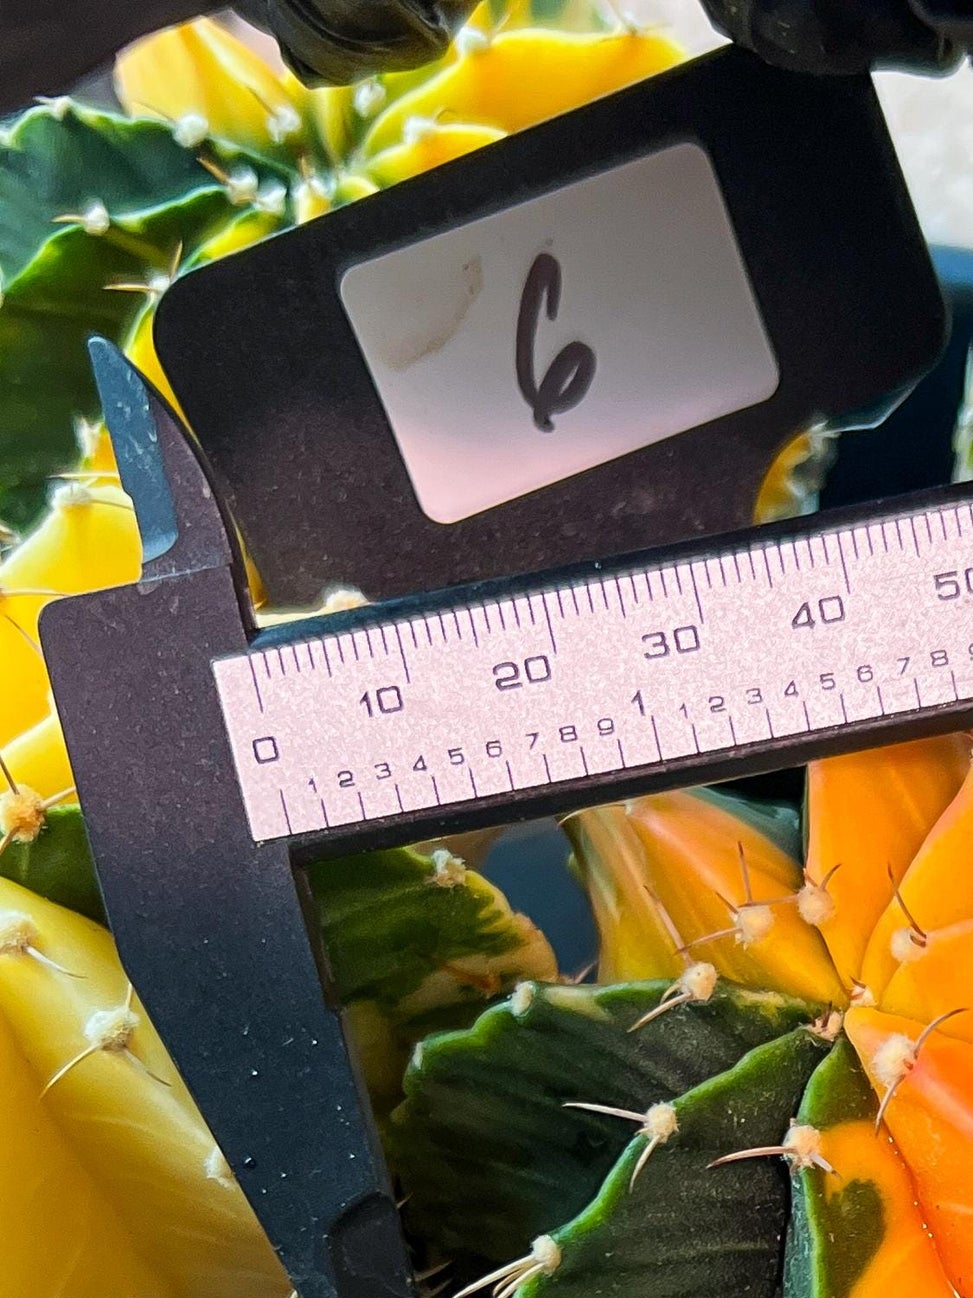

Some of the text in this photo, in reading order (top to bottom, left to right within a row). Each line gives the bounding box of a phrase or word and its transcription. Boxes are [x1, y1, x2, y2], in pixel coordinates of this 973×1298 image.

[516, 253, 596, 433] 6
[253, 736, 279, 764] 0
[360, 686, 403, 717] 10
[493, 655, 551, 691] 20
[642, 625, 700, 659] 30
[792, 595, 845, 629] 40
[308, 779, 316, 792] 1
[338, 771, 355, 787] 2
[374, 763, 391, 780] 3
[413, 755, 427, 771] 4
[448, 748, 464, 765] 5
[486, 740, 502, 757] 6
[526, 732, 539, 749] 7
[559, 726, 578, 742] 8
[597, 718, 614, 736] 9
[631, 690, 645, 715] 1
[680, 703, 688, 718] 1
[709, 696, 726, 712] 2
[746, 688, 763, 704] 3
[784, 680, 798, 696] 4
[820, 673, 835, 690] 5
[857, 665, 873, 682] 6
[897, 657, 910, 675] 7
[930, 650, 948, 667] 8
